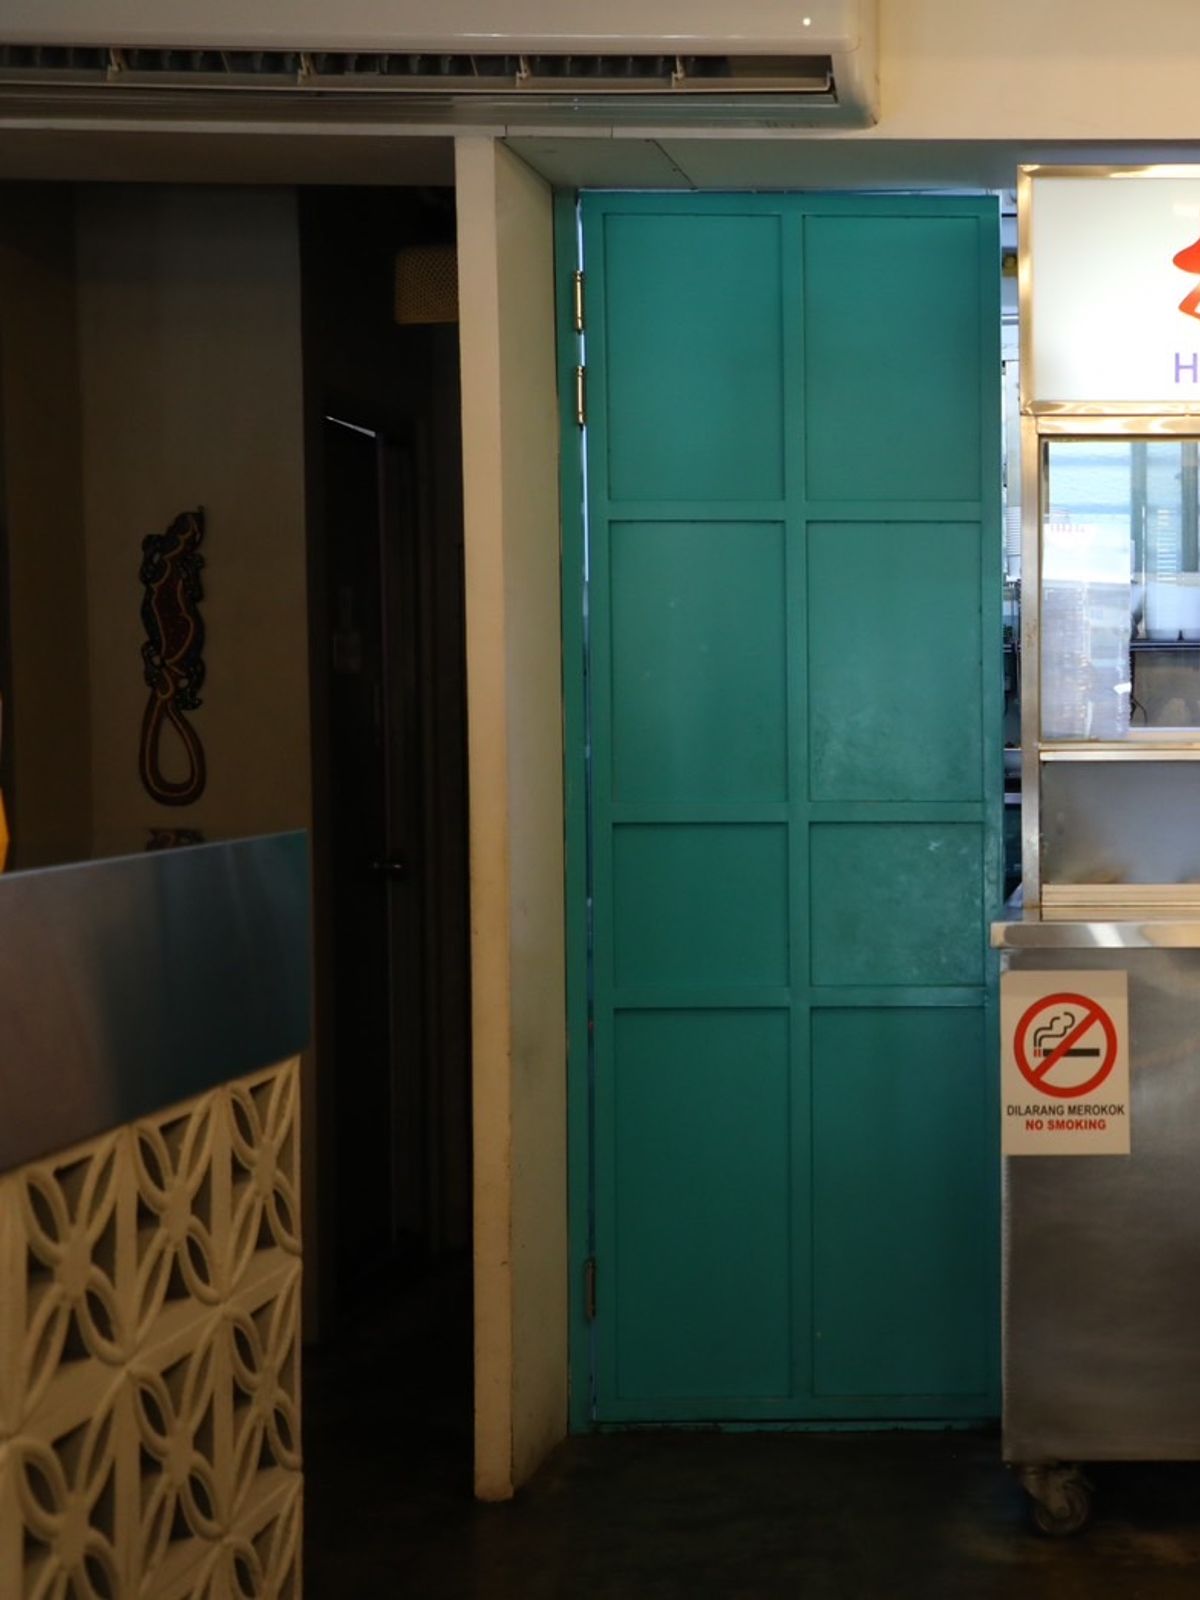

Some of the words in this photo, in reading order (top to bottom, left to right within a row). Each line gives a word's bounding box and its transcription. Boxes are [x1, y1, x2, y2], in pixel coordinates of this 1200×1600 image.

[1006, 1105, 1065, 1116] DILARANG
[1067, 1104, 1126, 1116] MEROKOK
[1025, 1119, 1044, 1131] NO
[1047, 1119, 1107, 1131] SMOKING
